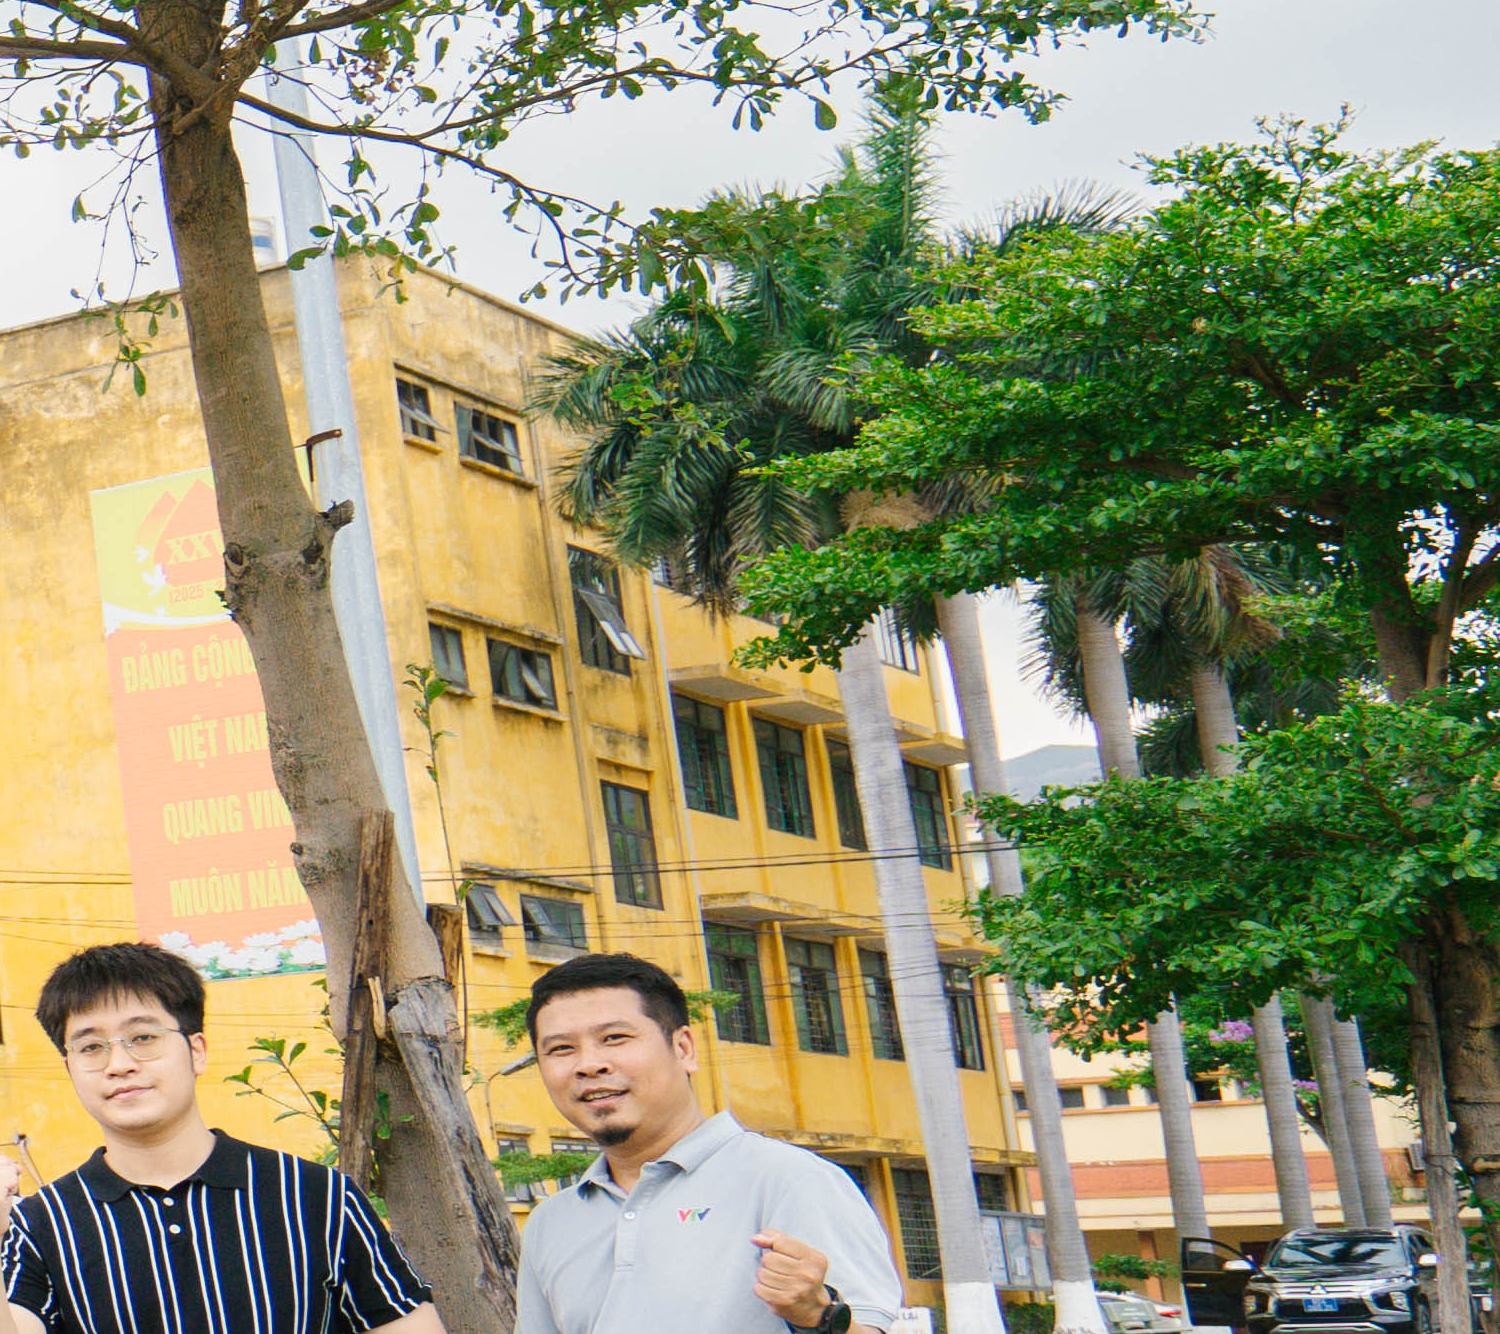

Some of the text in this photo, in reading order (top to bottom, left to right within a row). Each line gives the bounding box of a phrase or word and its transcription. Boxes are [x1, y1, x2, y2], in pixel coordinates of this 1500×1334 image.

[122, 642, 187, 694] ĐẢNG
[168, 714, 218, 768] VIỆT
[163, 789, 293, 844] QUANG VIN
[169, 867, 244, 918] MUÔN
